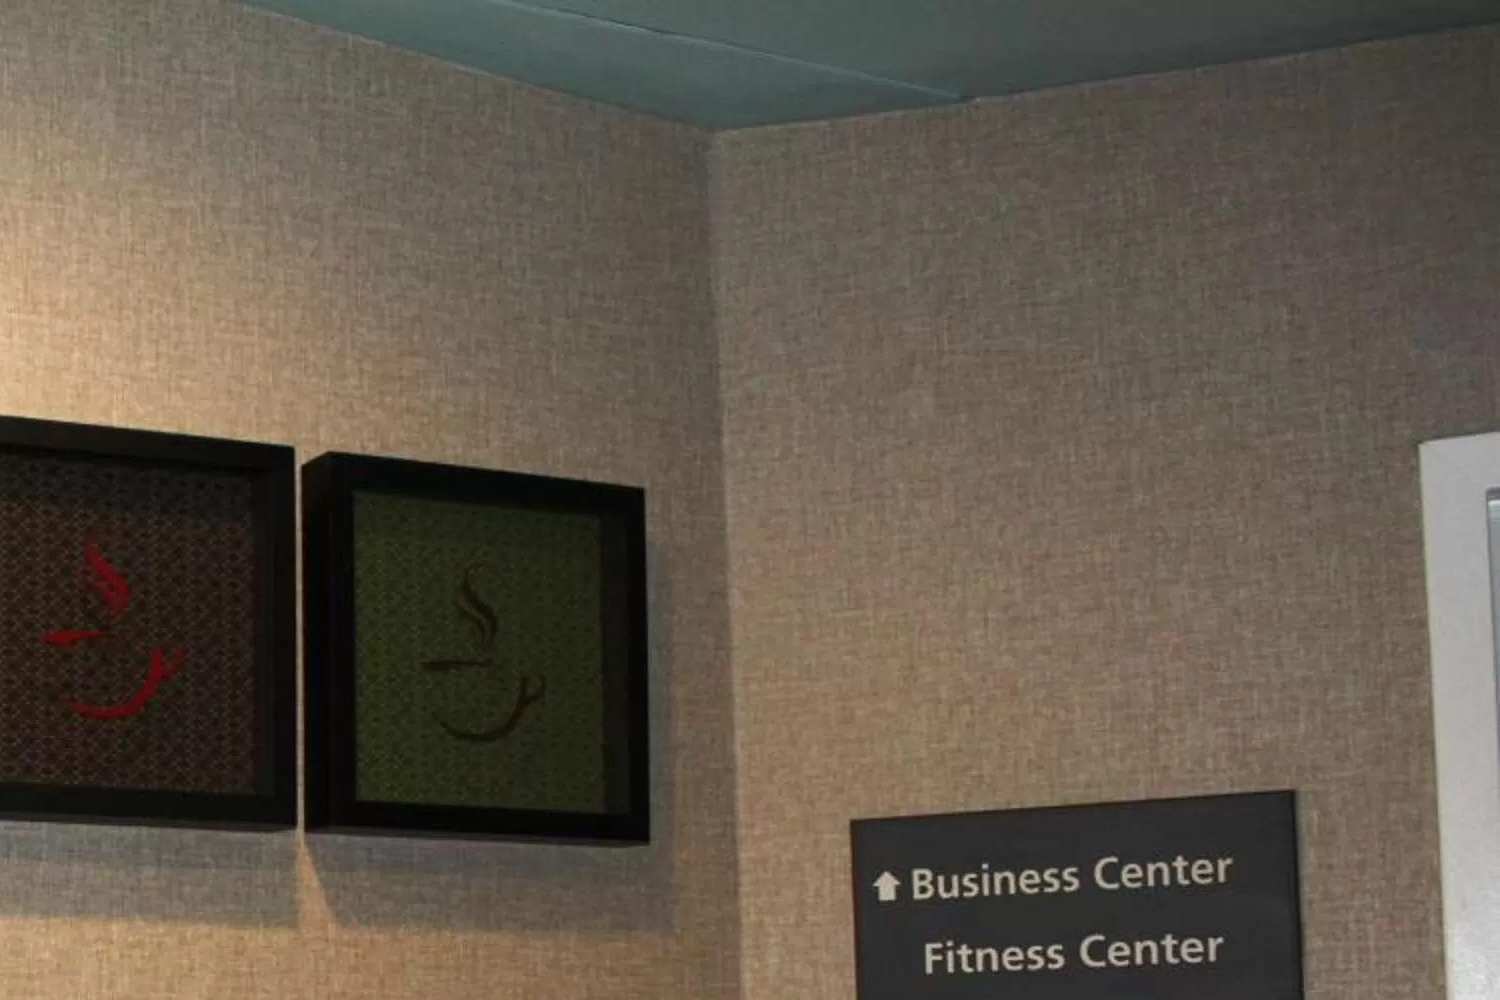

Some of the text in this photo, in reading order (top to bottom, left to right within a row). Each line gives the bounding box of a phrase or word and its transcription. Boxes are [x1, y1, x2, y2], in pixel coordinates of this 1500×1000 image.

[911, 854, 1234, 901] Business Center
[924, 933, 1225, 976] Fitness Center
